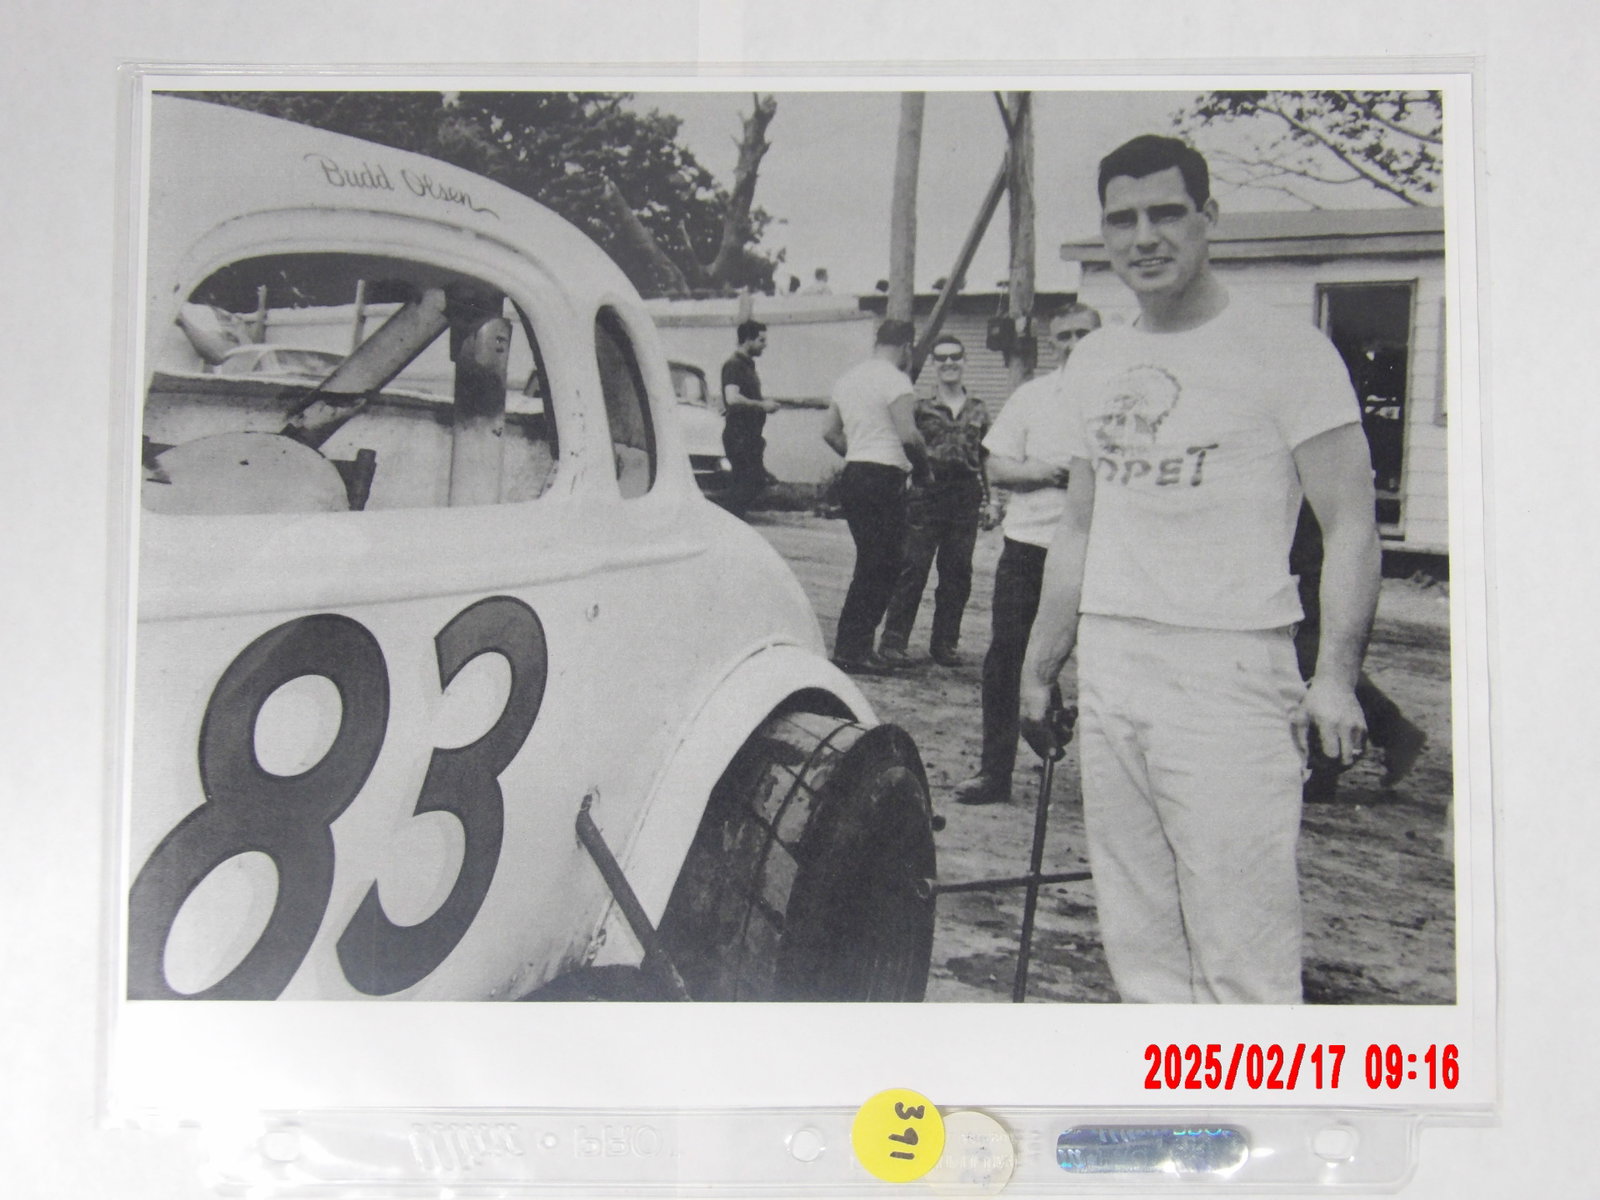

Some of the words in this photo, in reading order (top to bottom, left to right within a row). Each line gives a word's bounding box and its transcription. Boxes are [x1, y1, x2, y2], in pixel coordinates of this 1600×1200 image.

[304, 153, 395, 191] Budd
[401, 168, 499, 219] Olsen
[127, 595, 548, 1001] 83
[888, 1101, 925, 1160] 391
